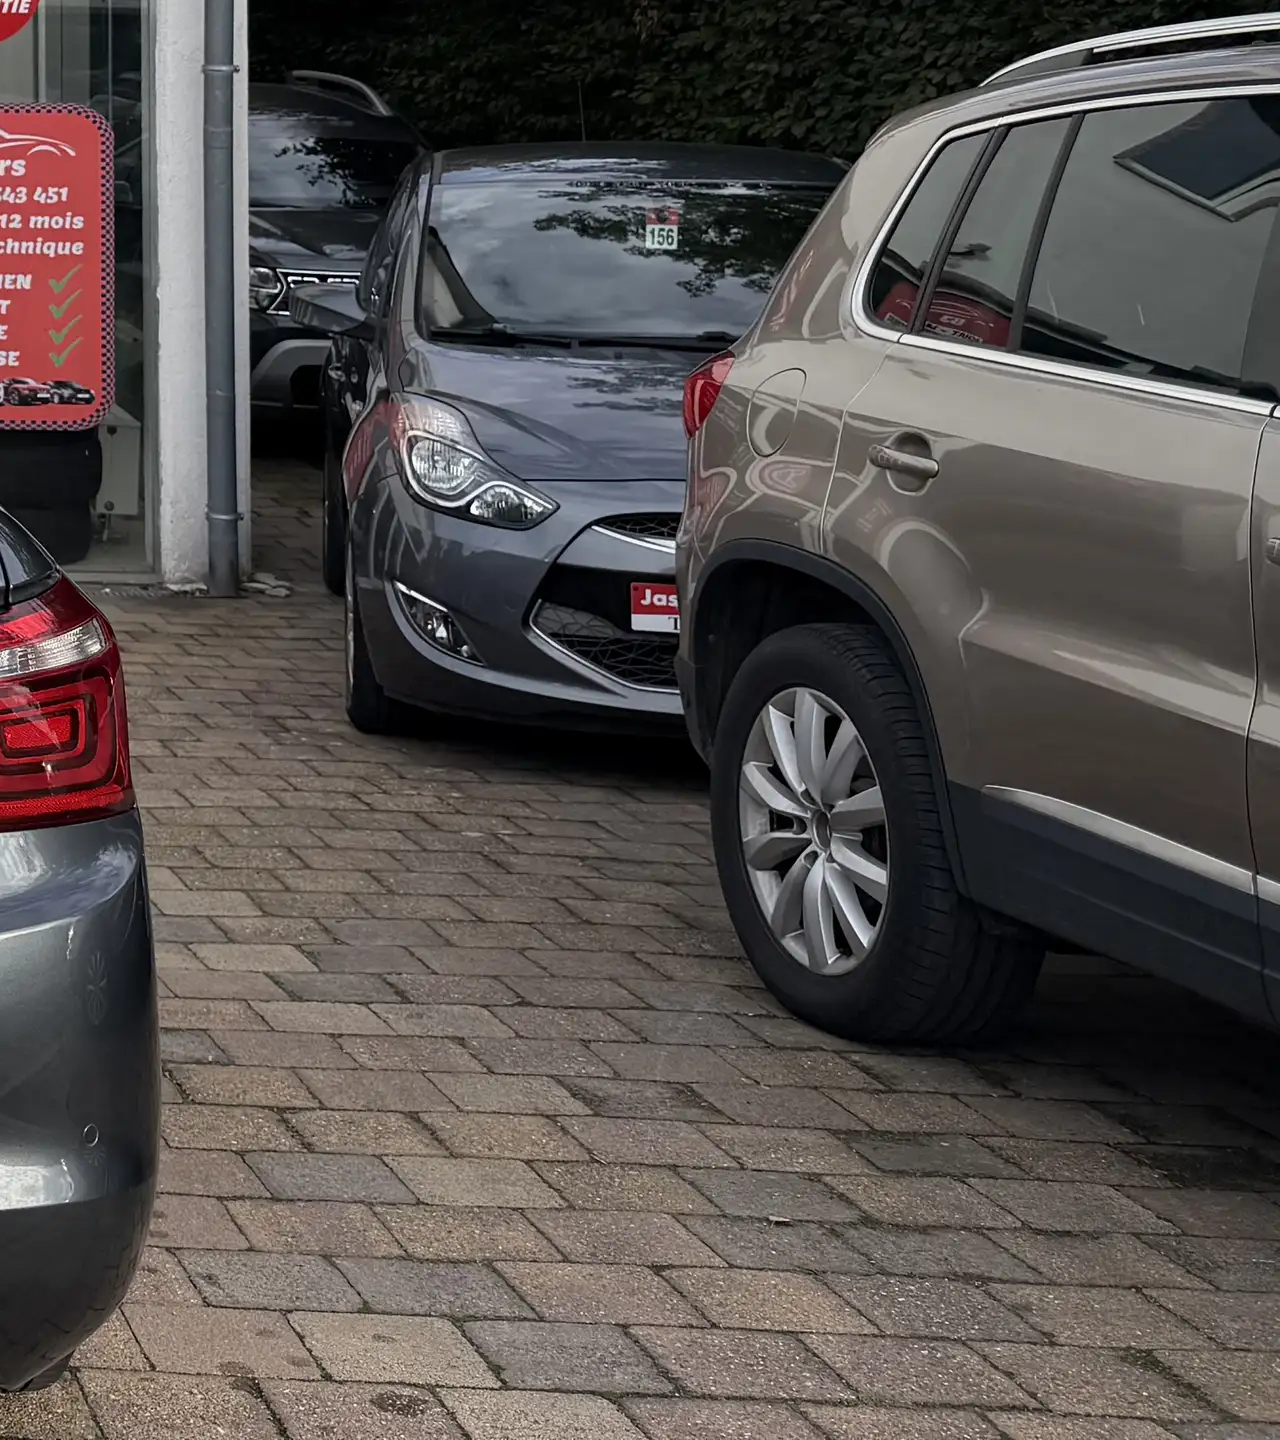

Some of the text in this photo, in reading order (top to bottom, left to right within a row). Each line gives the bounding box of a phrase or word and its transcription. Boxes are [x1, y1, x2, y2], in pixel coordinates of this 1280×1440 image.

[33, 186, 69, 204] 451
[29, 212, 85, 229] mois
[649, 227, 675, 246] 156
[640, 588, 678, 608] Jas
